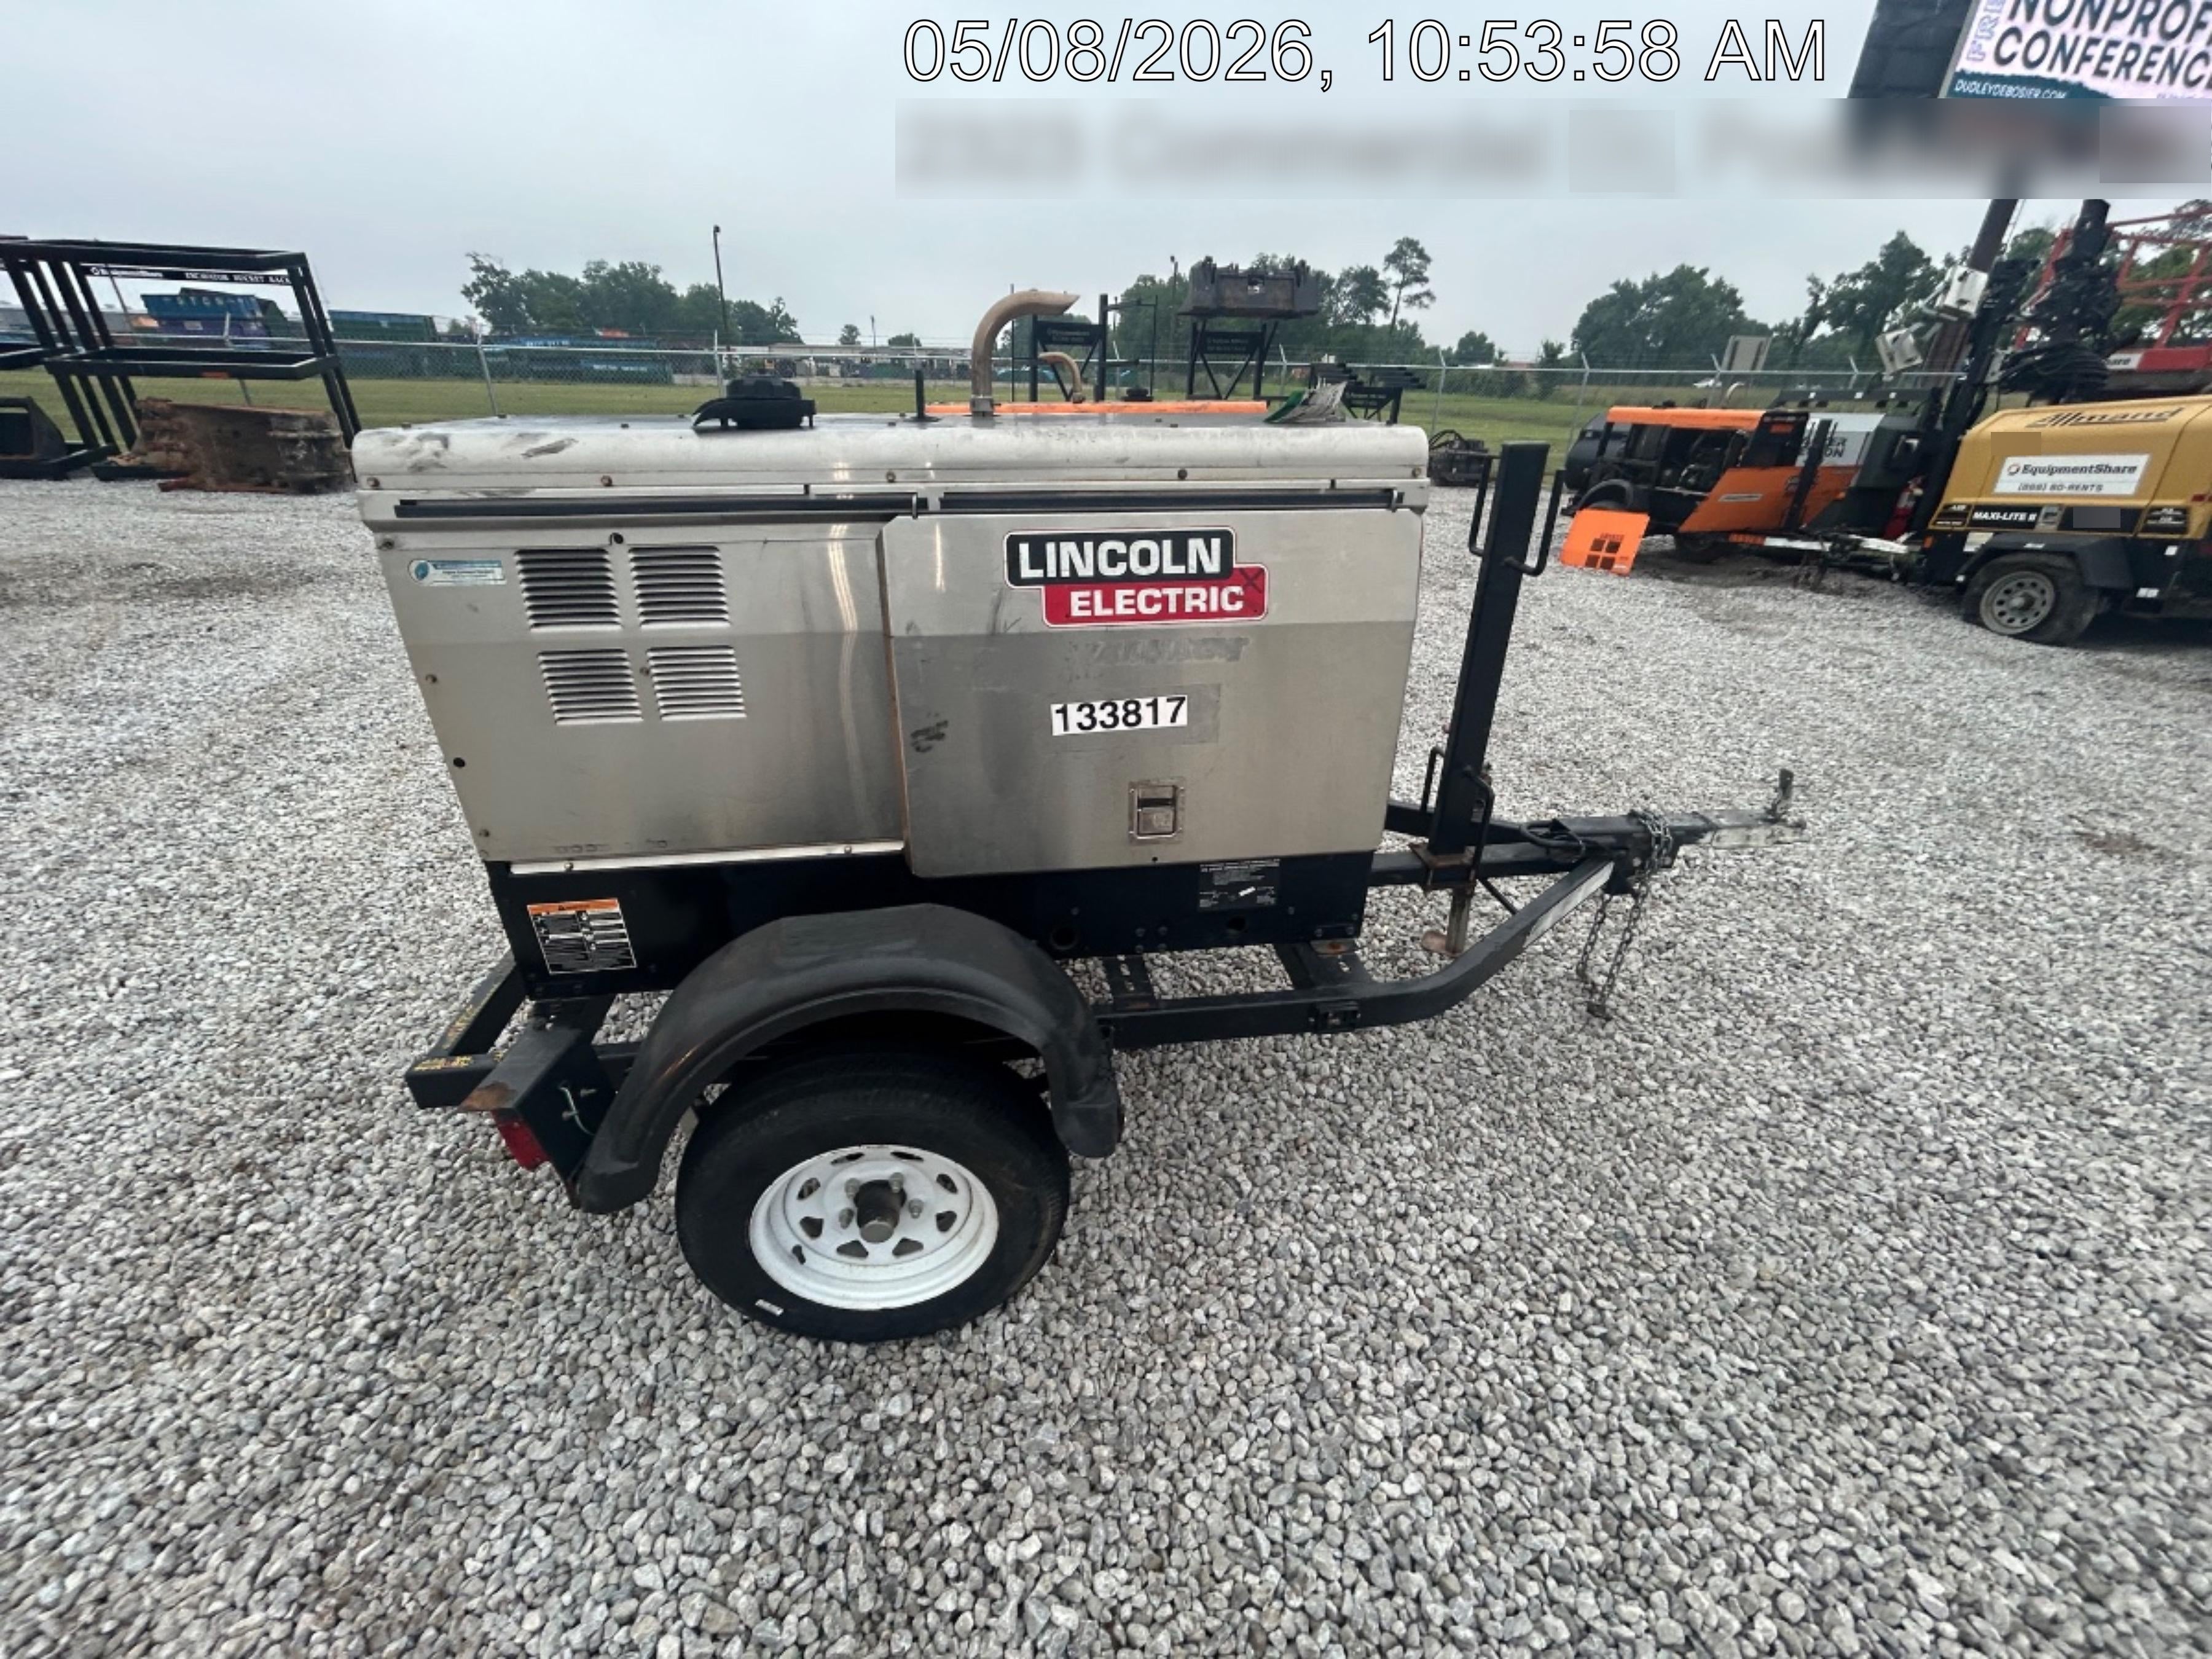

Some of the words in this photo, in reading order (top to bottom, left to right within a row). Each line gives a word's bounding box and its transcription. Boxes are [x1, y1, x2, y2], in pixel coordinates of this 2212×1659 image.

[1994, 26, 2212, 90] CONFERENC
[2021, 463, 2138, 476] EquipmentShare
[1972, 511, 2027, 522] MAXI-LITE
[1019, 538, 1222, 579] LINCOLN
[1070, 586, 1244, 617] ELECTRIC
[1055, 696, 1186, 732] 133817
